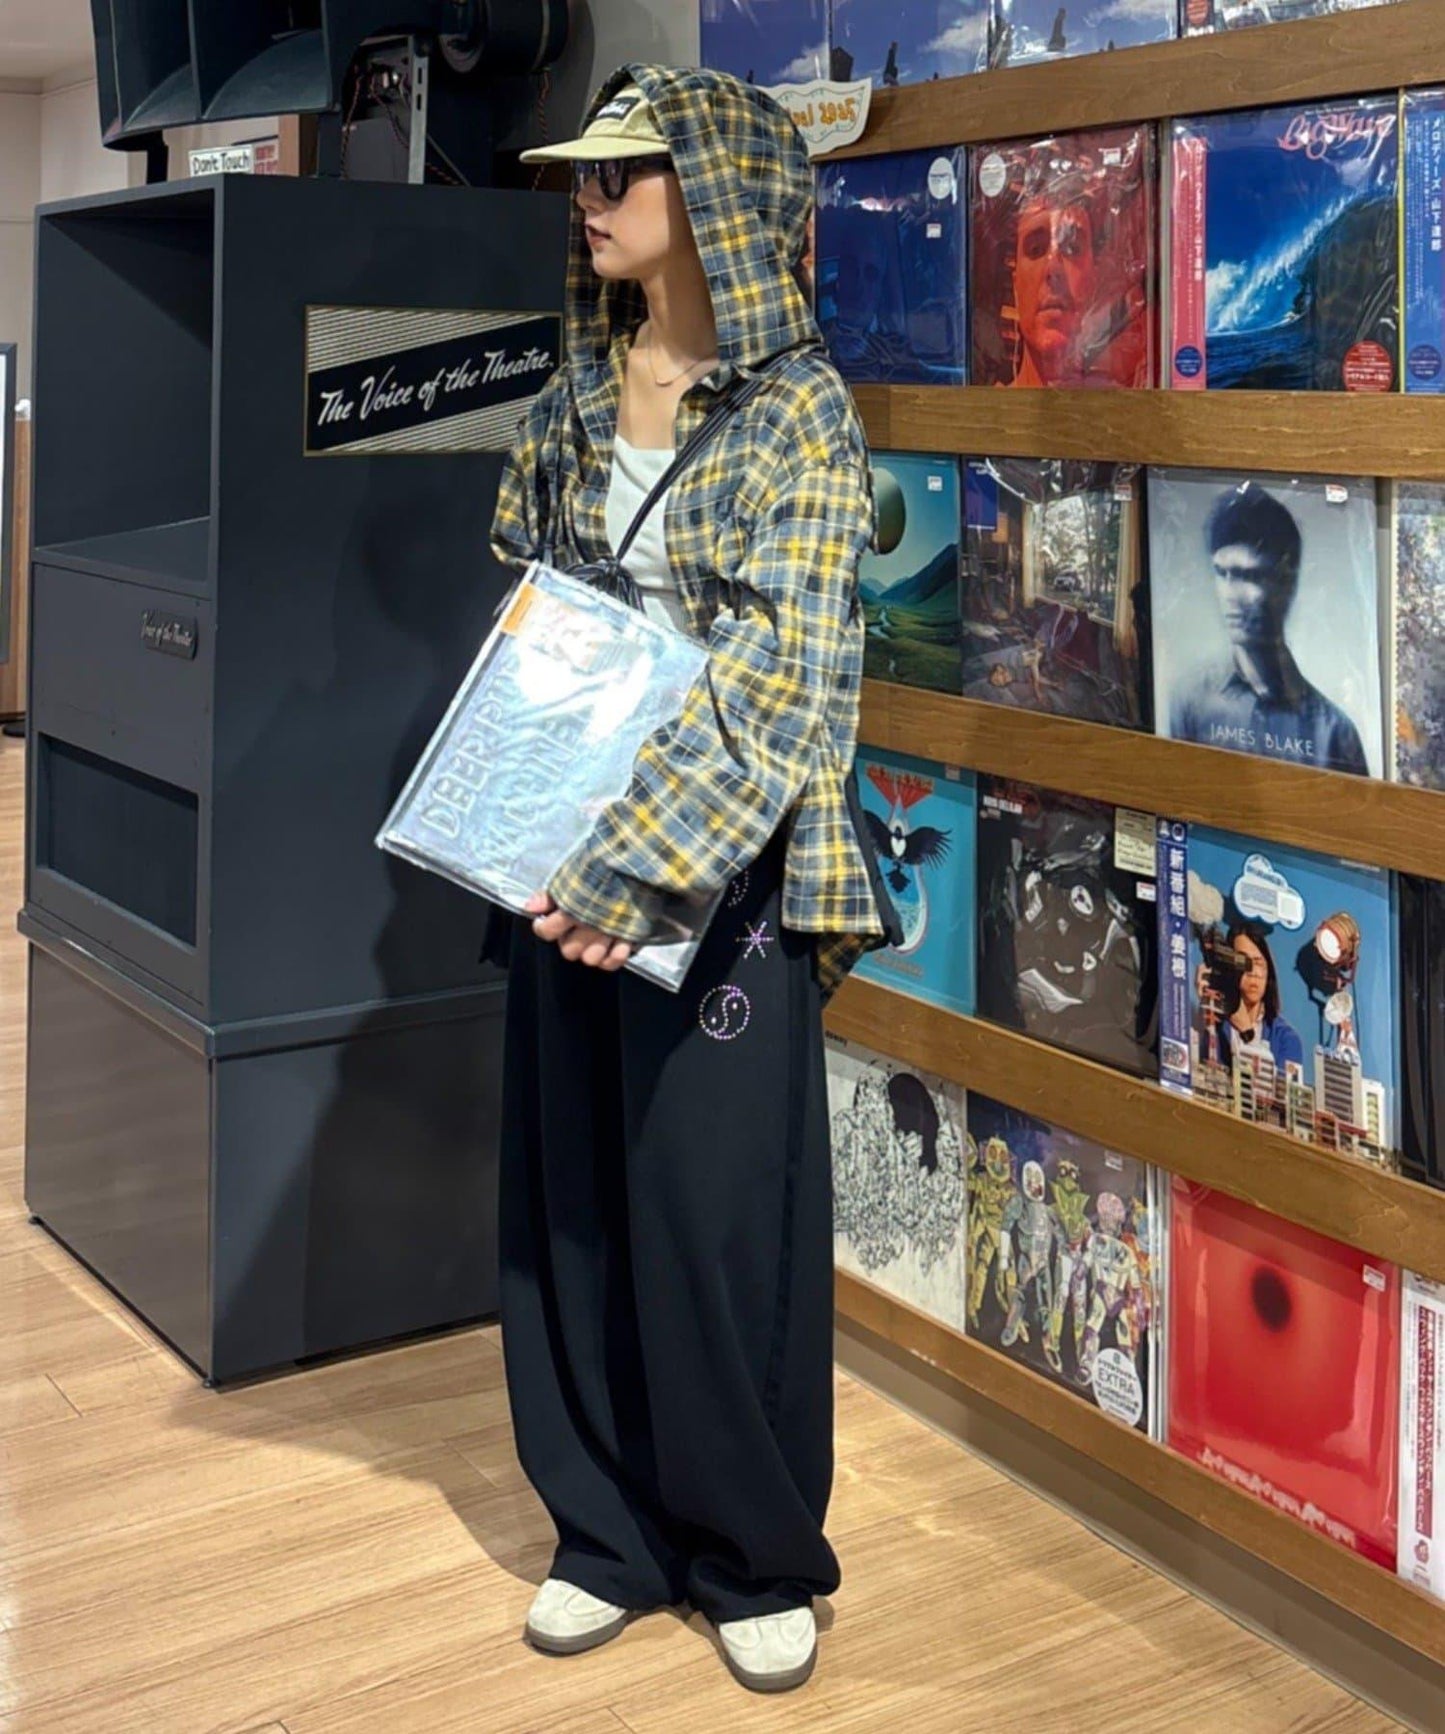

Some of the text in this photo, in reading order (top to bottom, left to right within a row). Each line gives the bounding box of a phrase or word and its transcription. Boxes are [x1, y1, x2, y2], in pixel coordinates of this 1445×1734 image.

[220, 151, 250, 171] Touch
[317, 389, 353, 427] The
[360, 365, 412, 421] Voice
[418, 367, 444, 411] of
[444, 359, 477, 393] the
[1210, 723, 1314, 757] JAMES BLAKE
[419, 735, 498, 840] DEEP
[1099, 1367, 1135, 1397] EXTRA
